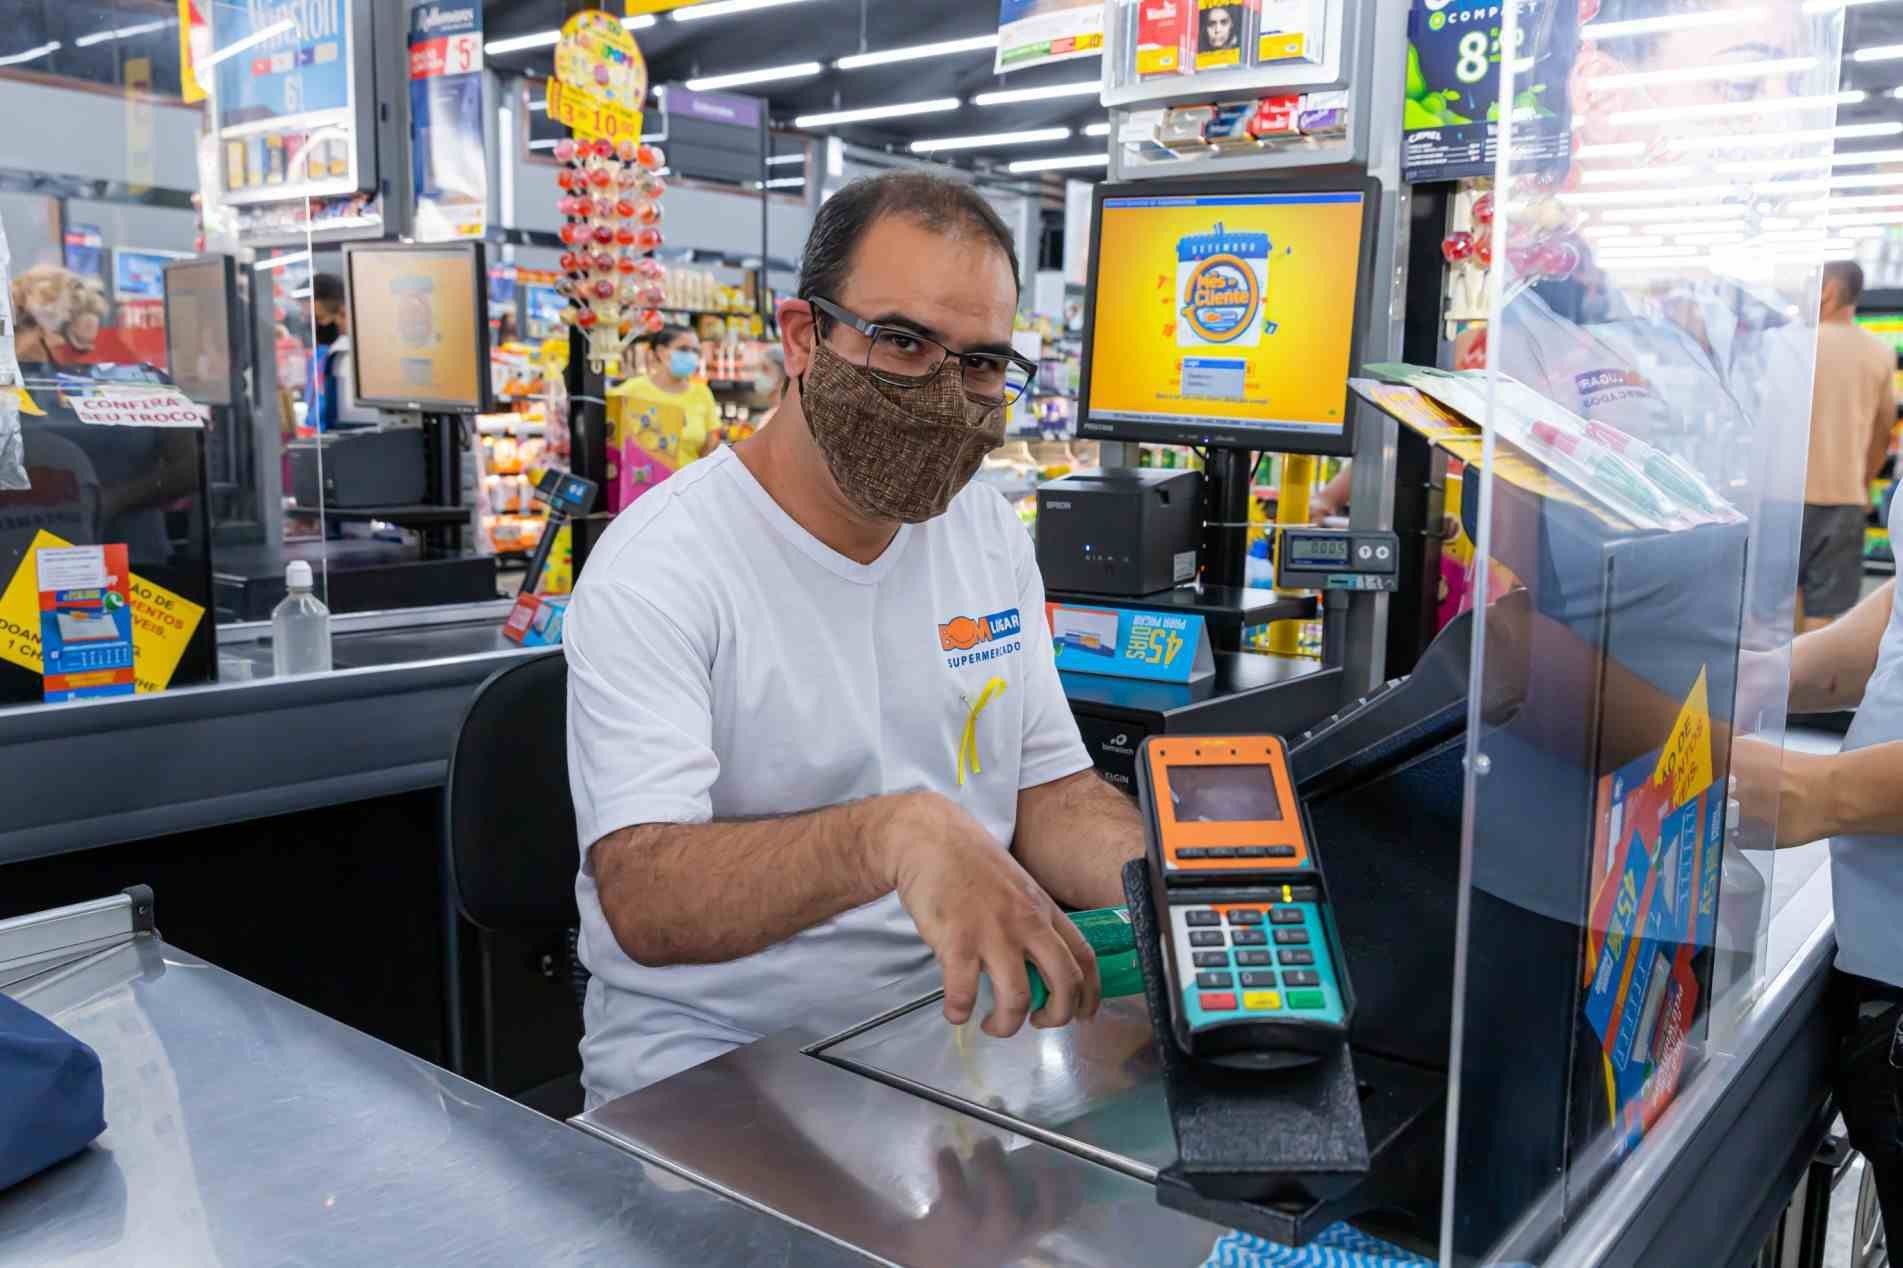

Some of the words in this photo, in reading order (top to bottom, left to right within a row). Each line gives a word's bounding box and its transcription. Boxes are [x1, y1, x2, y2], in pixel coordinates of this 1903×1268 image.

[1448, 3, 1537, 24] COMPCT
[83, 398, 178, 410] CONFIRA
[80, 412, 121, 422] SEU
[127, 411, 198, 423] TROCO
[938, 615, 992, 652] BOM
[1145, 628, 1183, 669] 45
